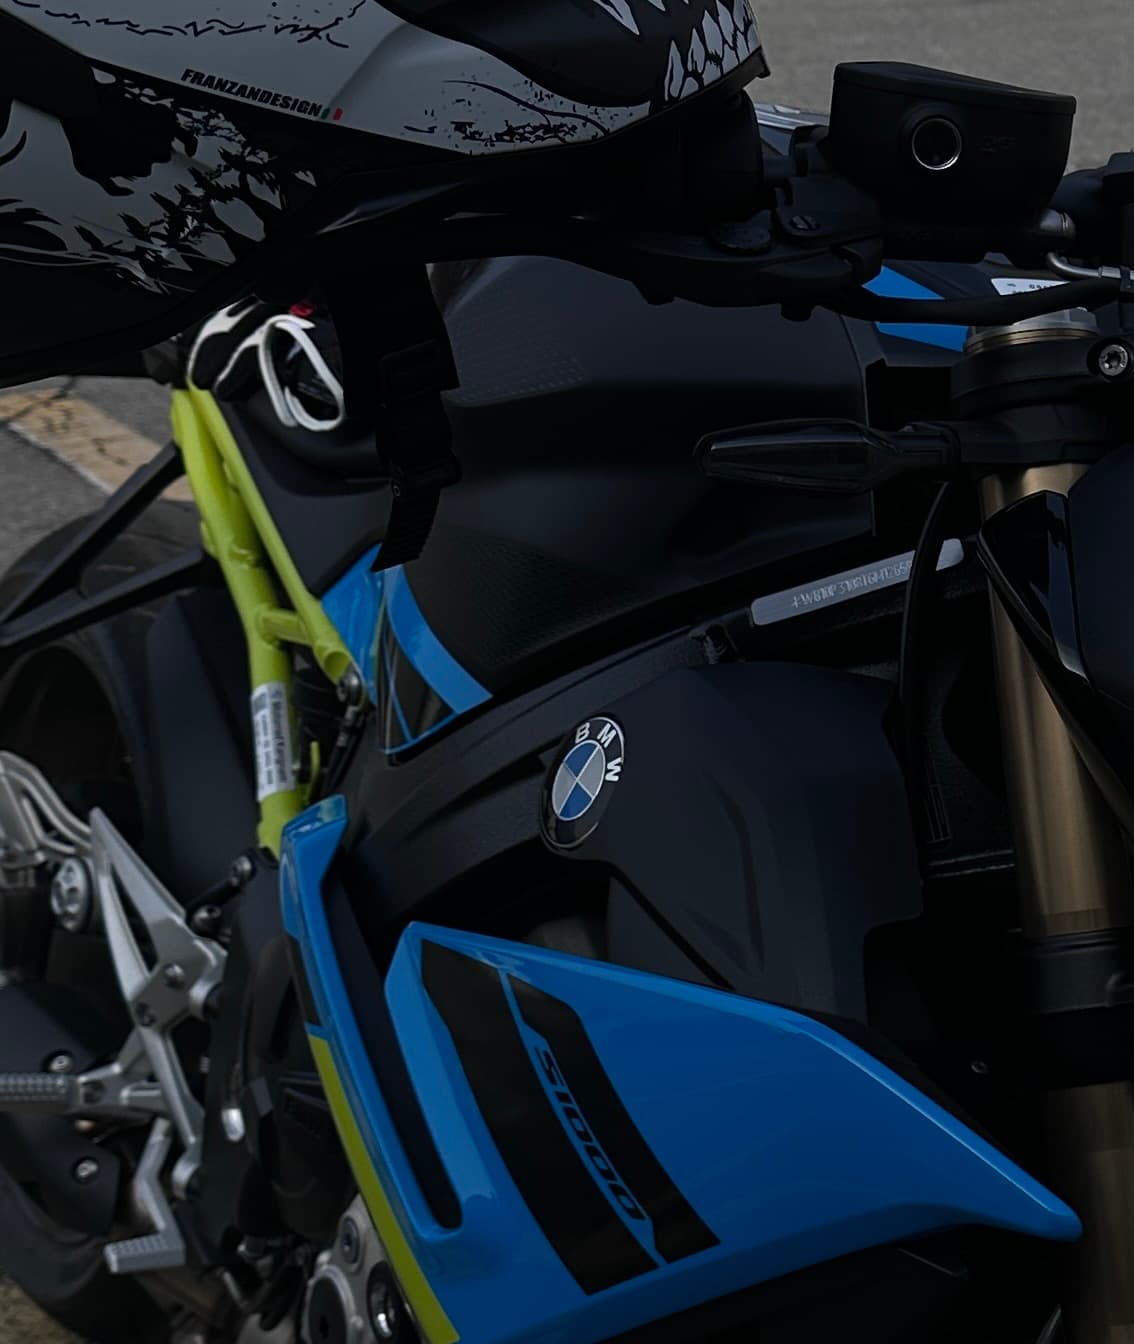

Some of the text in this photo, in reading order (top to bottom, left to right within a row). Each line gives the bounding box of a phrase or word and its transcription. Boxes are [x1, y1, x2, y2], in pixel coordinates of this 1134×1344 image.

[181, 69, 323, 116] FRANZANDESIGN
[575, 721, 623, 782] BMW
[535, 1047, 646, 1219] S1000
